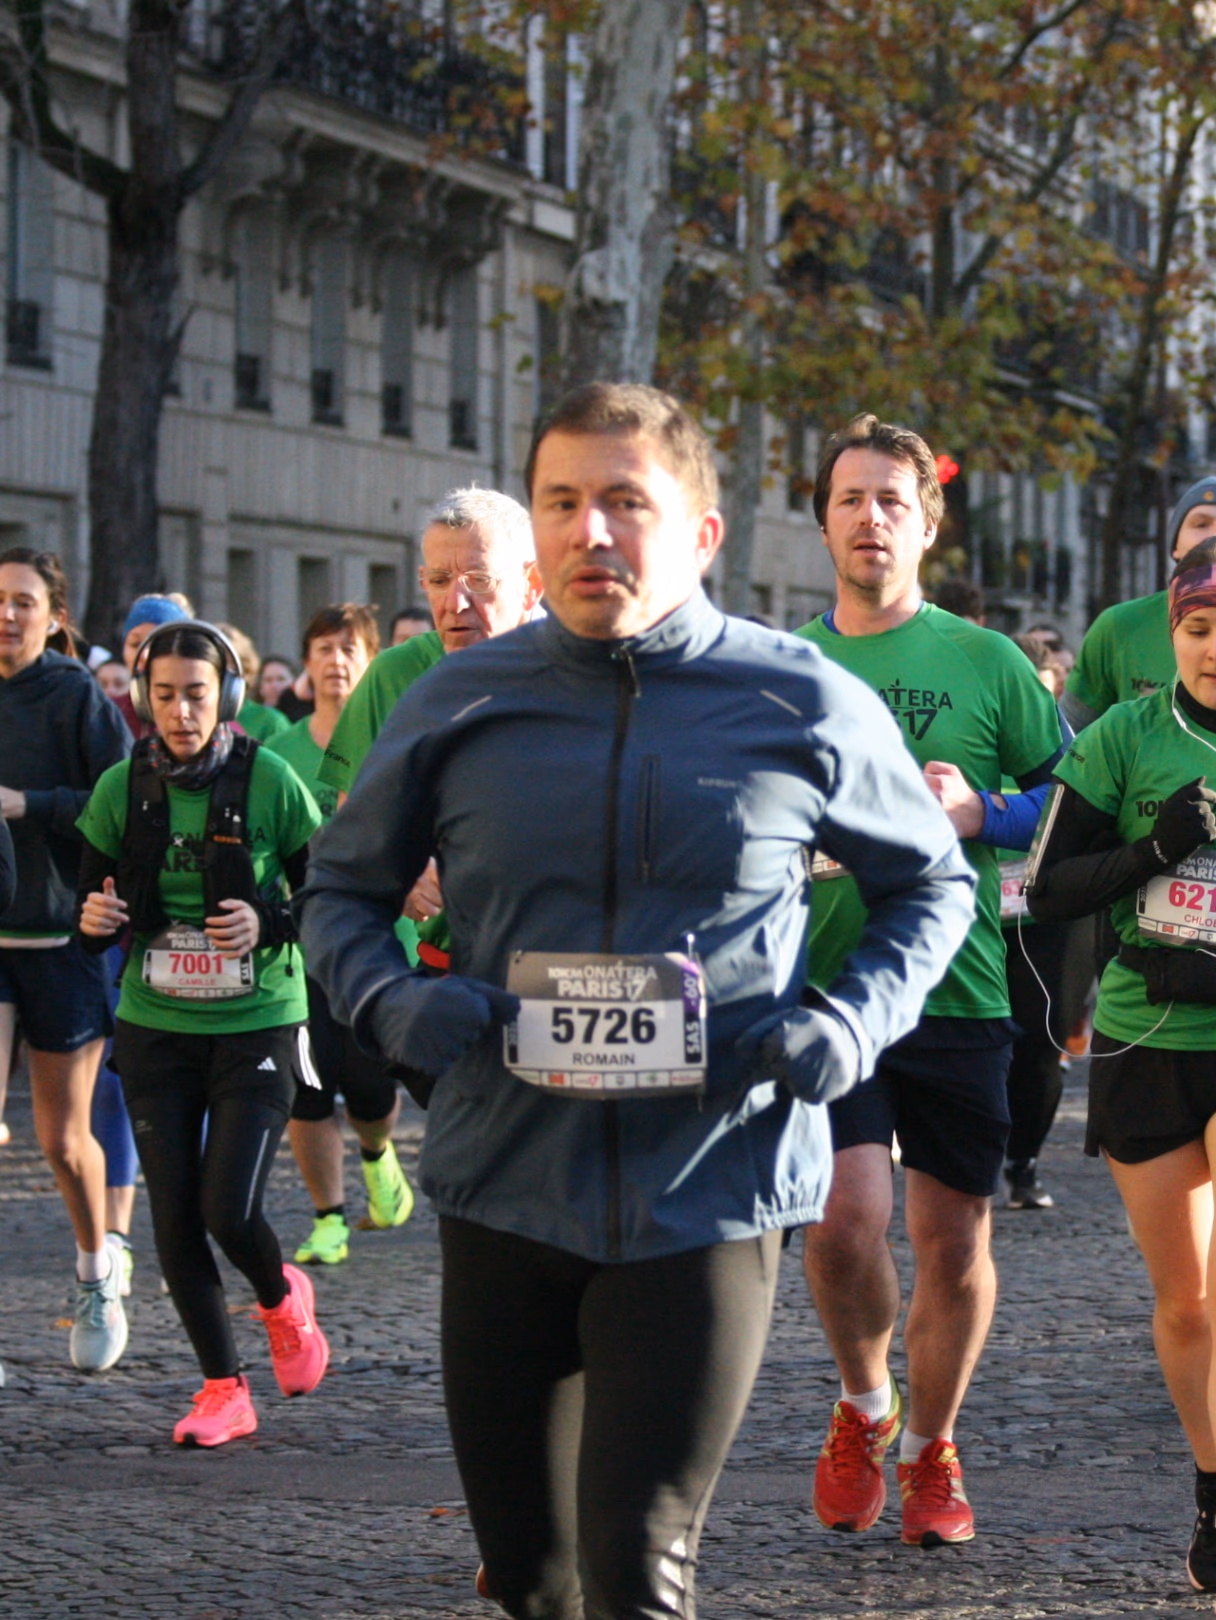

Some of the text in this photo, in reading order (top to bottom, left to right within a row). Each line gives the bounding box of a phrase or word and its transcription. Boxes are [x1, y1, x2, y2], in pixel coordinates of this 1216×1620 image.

[878, 686, 953, 710] ATERA
[903, 708, 938, 741] 17
[169, 953, 223, 975] 7001
[584, 963, 658, 979] ONATERA
[551, 1006, 657, 1044] 5726
[686, 1021, 699, 1054] SAS
[573, 1053, 636, 1065] ROMAIN
